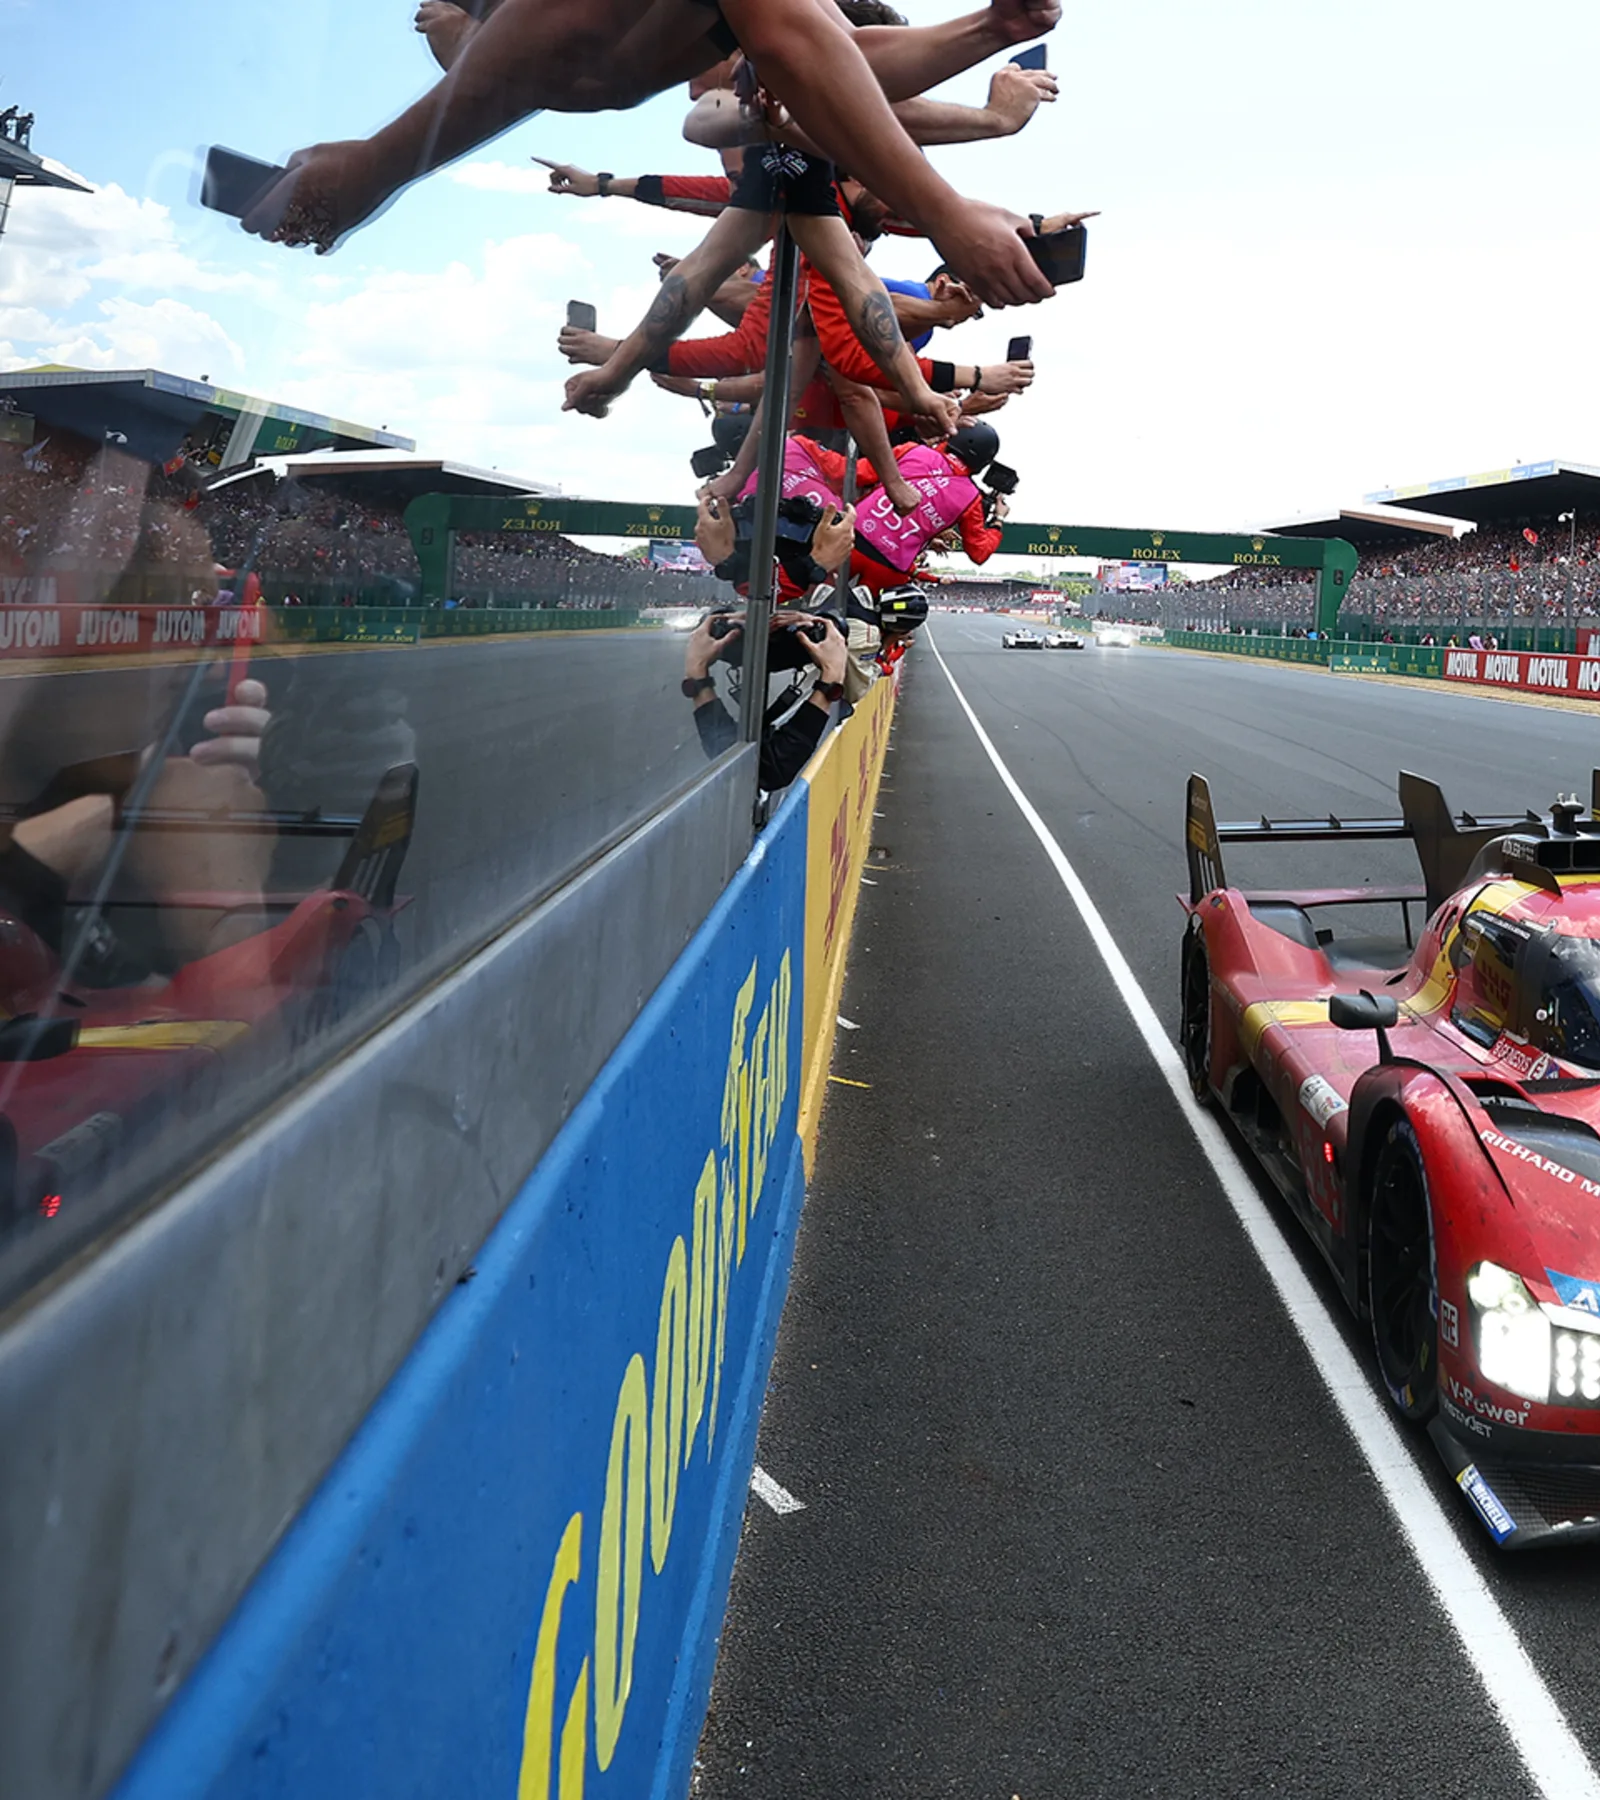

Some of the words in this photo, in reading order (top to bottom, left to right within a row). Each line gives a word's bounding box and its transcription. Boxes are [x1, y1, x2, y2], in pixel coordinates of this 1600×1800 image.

[1028, 542, 1078, 556] ROLEX
[1132, 548, 1181, 561] ROLEX
[1233, 552, 1281, 566] ROLEX
[1446, 652, 1478, 678] MOTUL
[1484, 655, 1520, 683] MOTUL
[1528, 658, 1568, 689] MOTUL
[1480, 1128, 1576, 1184] RICHARD
[1450, 1376, 1528, 1426] V-Power
[1470, 1483, 1512, 1534] MICHELIN
